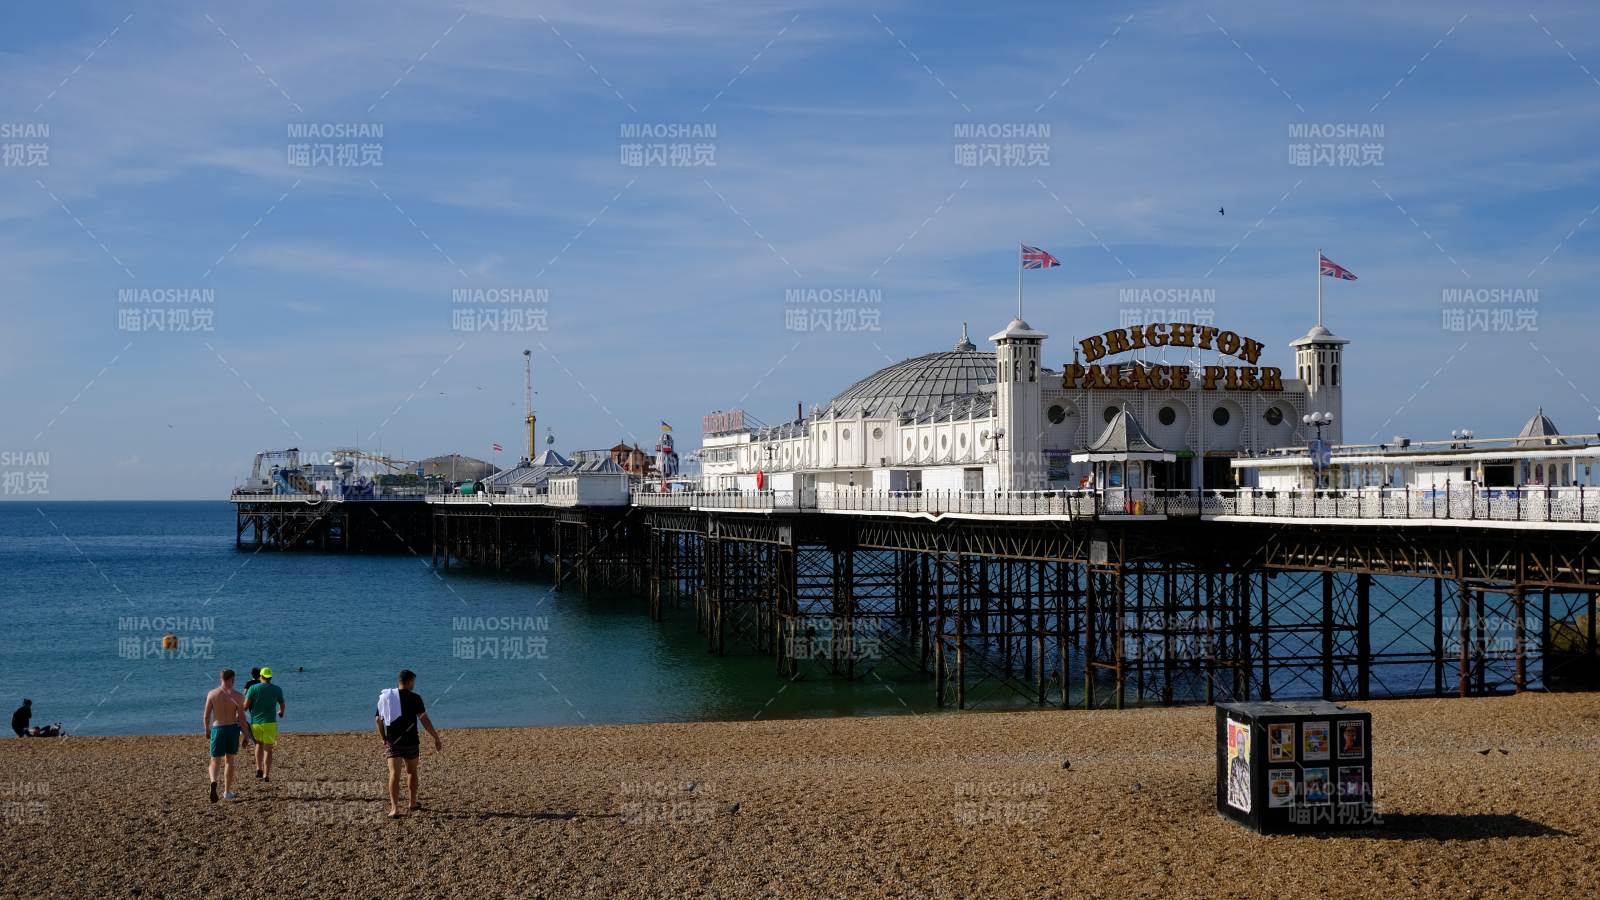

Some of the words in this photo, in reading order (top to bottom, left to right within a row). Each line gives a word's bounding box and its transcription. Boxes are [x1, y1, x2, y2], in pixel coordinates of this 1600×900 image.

[1079, 323, 1265, 365] BRIGHTON
[1062, 364, 1191, 391] PALACE
[1202, 366, 1284, 391] PIER
